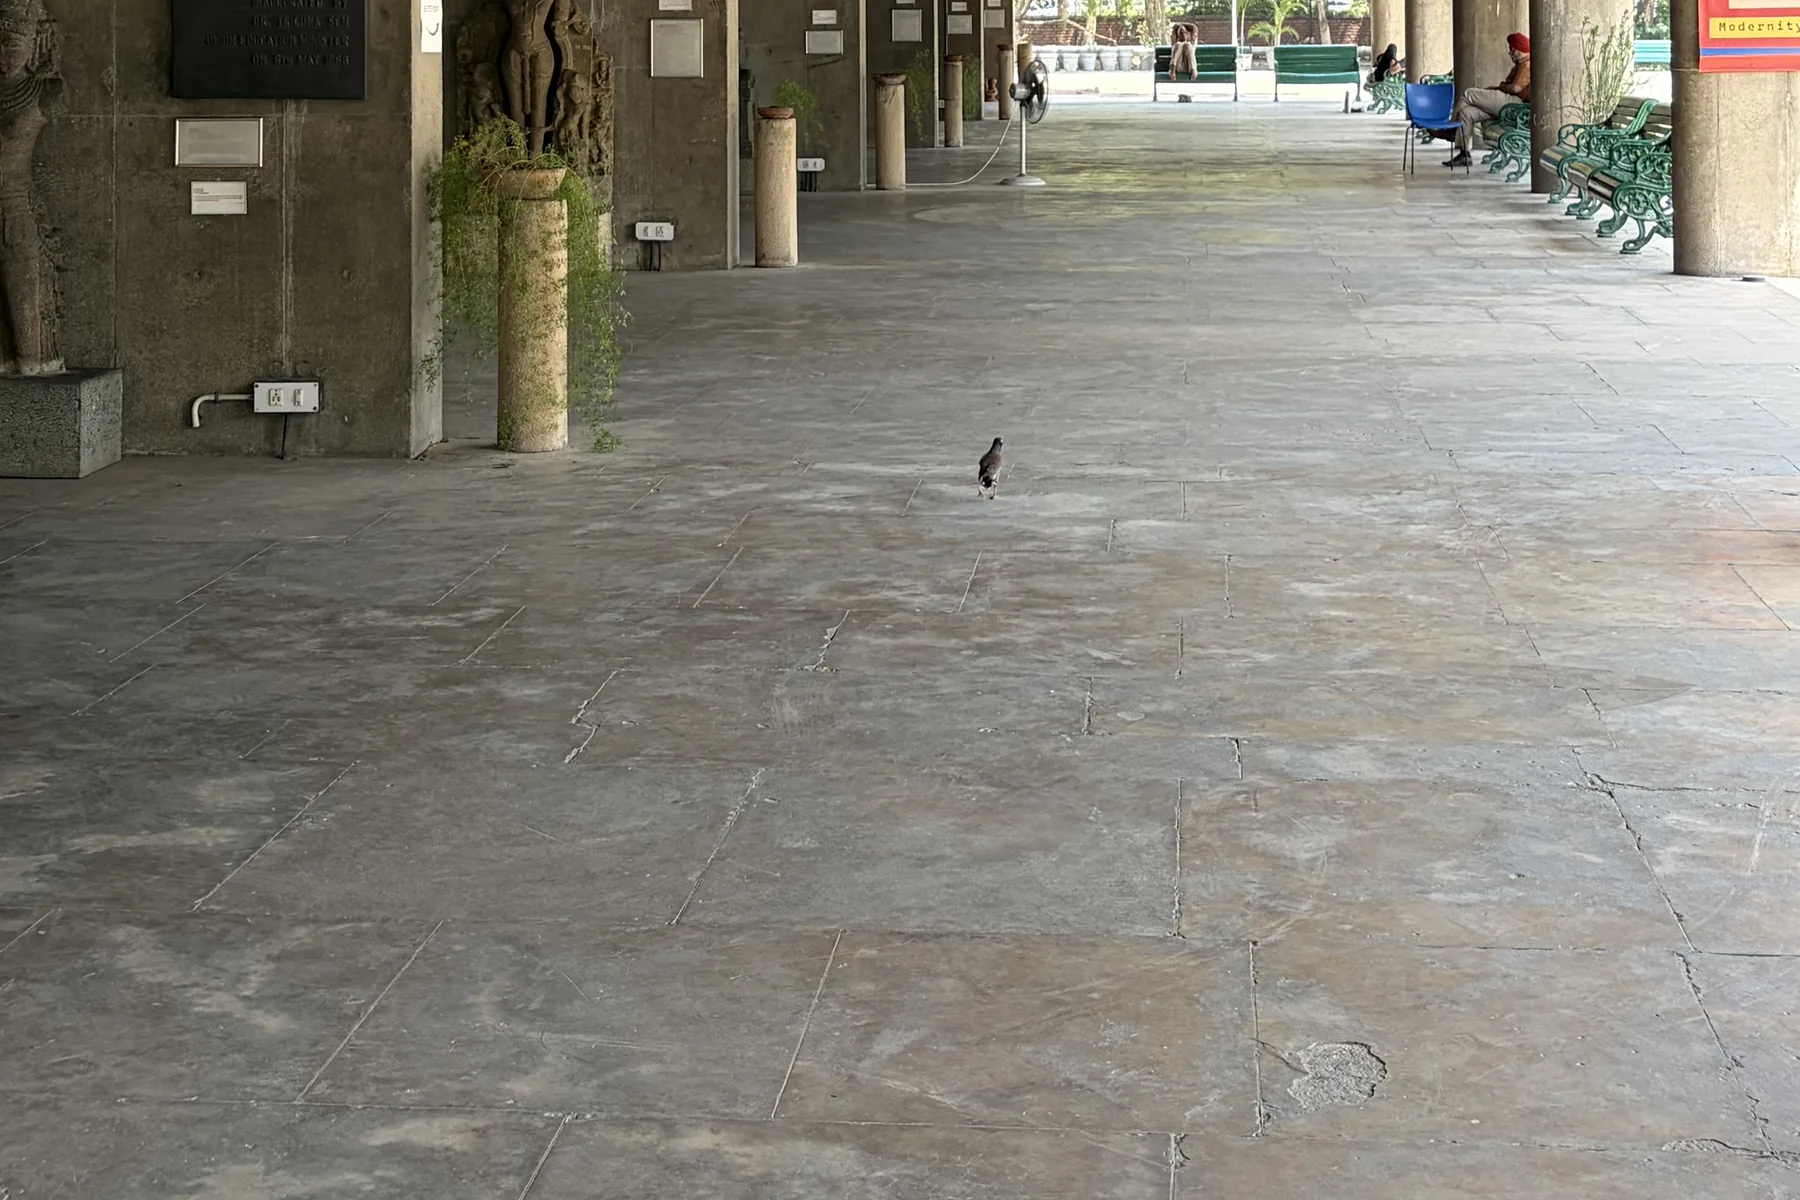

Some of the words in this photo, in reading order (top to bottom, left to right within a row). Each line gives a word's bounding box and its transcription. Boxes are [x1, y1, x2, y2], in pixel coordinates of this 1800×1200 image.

[327, 15, 350, 28] SEN
[1718, 20, 1800, 33] Modernity
[205, 34, 237, 47] UNION
[239, 34, 297, 47] EDUCATION
[299, 34, 349, 47] MINISTER
[251, 54, 267, 66] ON
[297, 54, 319, 66] MAY
